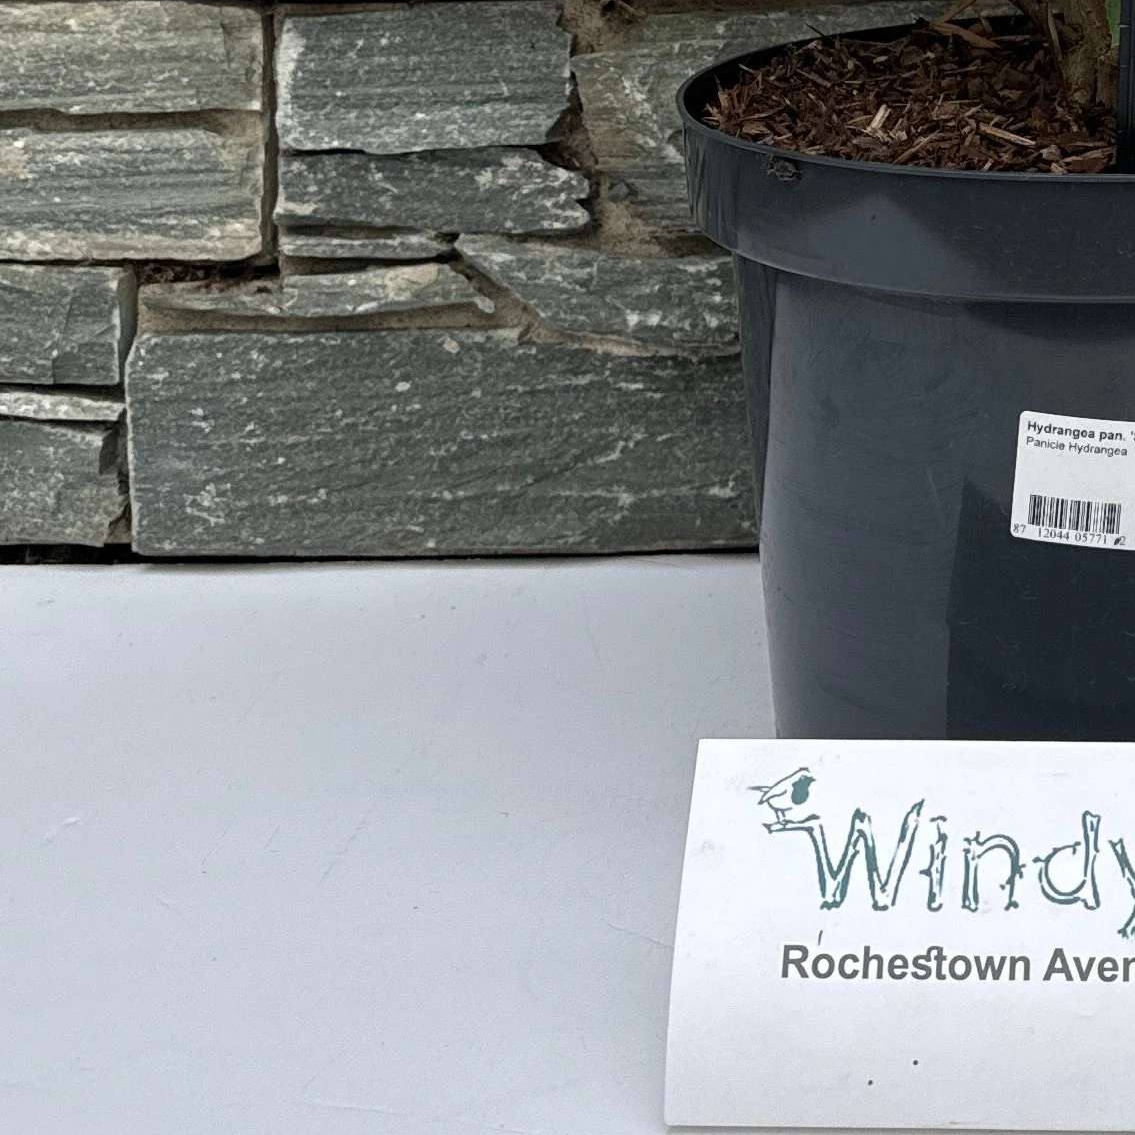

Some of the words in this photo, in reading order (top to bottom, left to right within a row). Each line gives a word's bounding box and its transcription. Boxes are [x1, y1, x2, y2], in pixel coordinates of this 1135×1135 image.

[1027, 420, 1095, 439] Hydrangea
[1099, 431, 1126, 442] pan.
[1026, 435, 1065, 450] Panicle
[1068, 441, 1128, 457] Hydrangea
[1013, 524, 1026, 533] 87
[1037, 527, 1070, 541] 12044
[1074, 531, 1107, 545] 05771
[781, 944, 1030, 981] Rochestown
